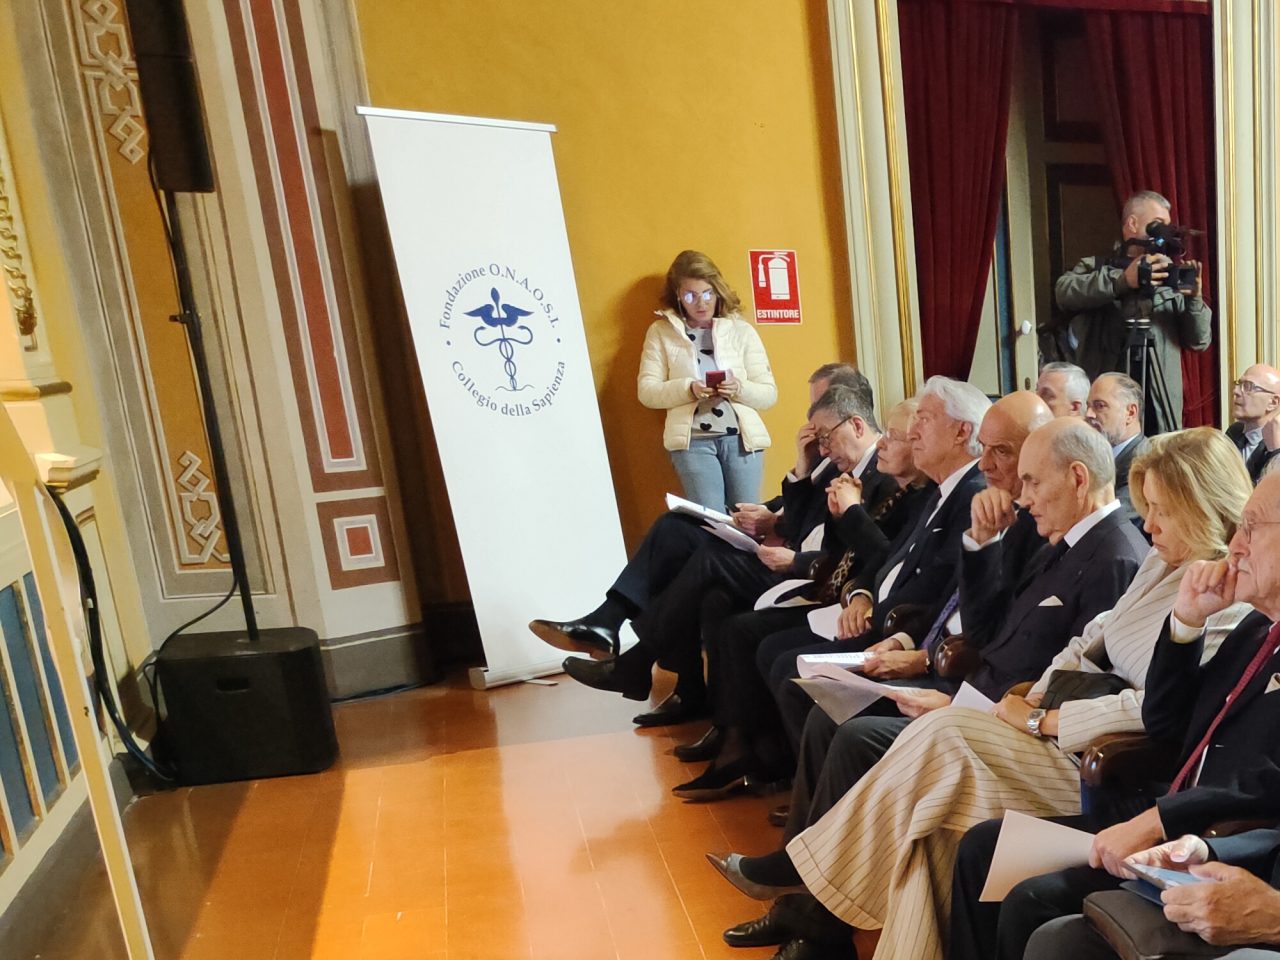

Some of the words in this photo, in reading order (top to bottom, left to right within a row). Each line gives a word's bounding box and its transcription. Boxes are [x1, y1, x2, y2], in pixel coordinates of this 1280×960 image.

[439, 266, 487, 329] Fondazione
[489, 263, 560, 329] O.N.A.O.S.I.
[757, 309, 800, 319] ESTINTORE
[452, 360, 498, 411] Collegio
[500, 403, 532, 417] della
[531, 361, 566, 412] Sapienza
